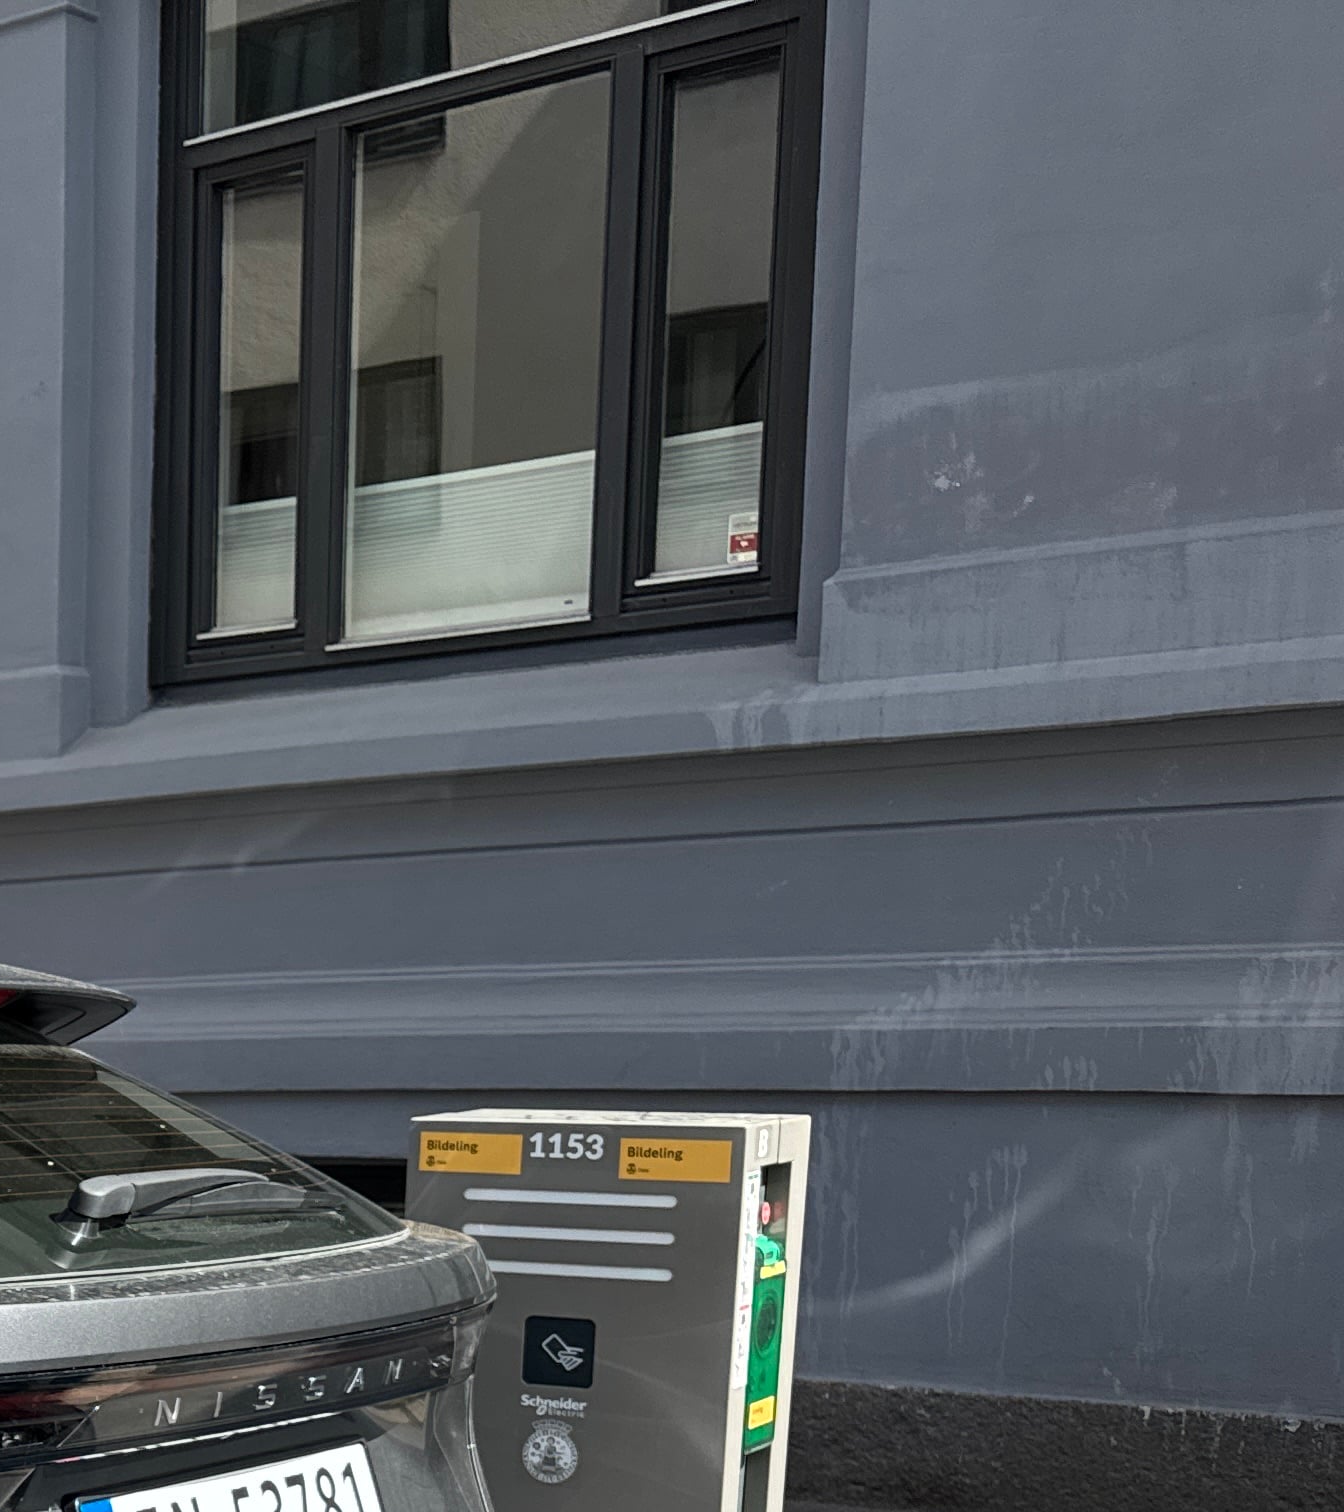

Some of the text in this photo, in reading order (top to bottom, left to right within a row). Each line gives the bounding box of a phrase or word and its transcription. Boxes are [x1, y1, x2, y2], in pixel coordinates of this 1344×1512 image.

[426, 1139, 479, 1154] Bildeling
[529, 1132, 605, 1160] 1153
[627, 1146, 684, 1161] Bildeling
[154, 1358, 405, 1427] NISSAN
[520, 1393, 588, 1411] Schneider
